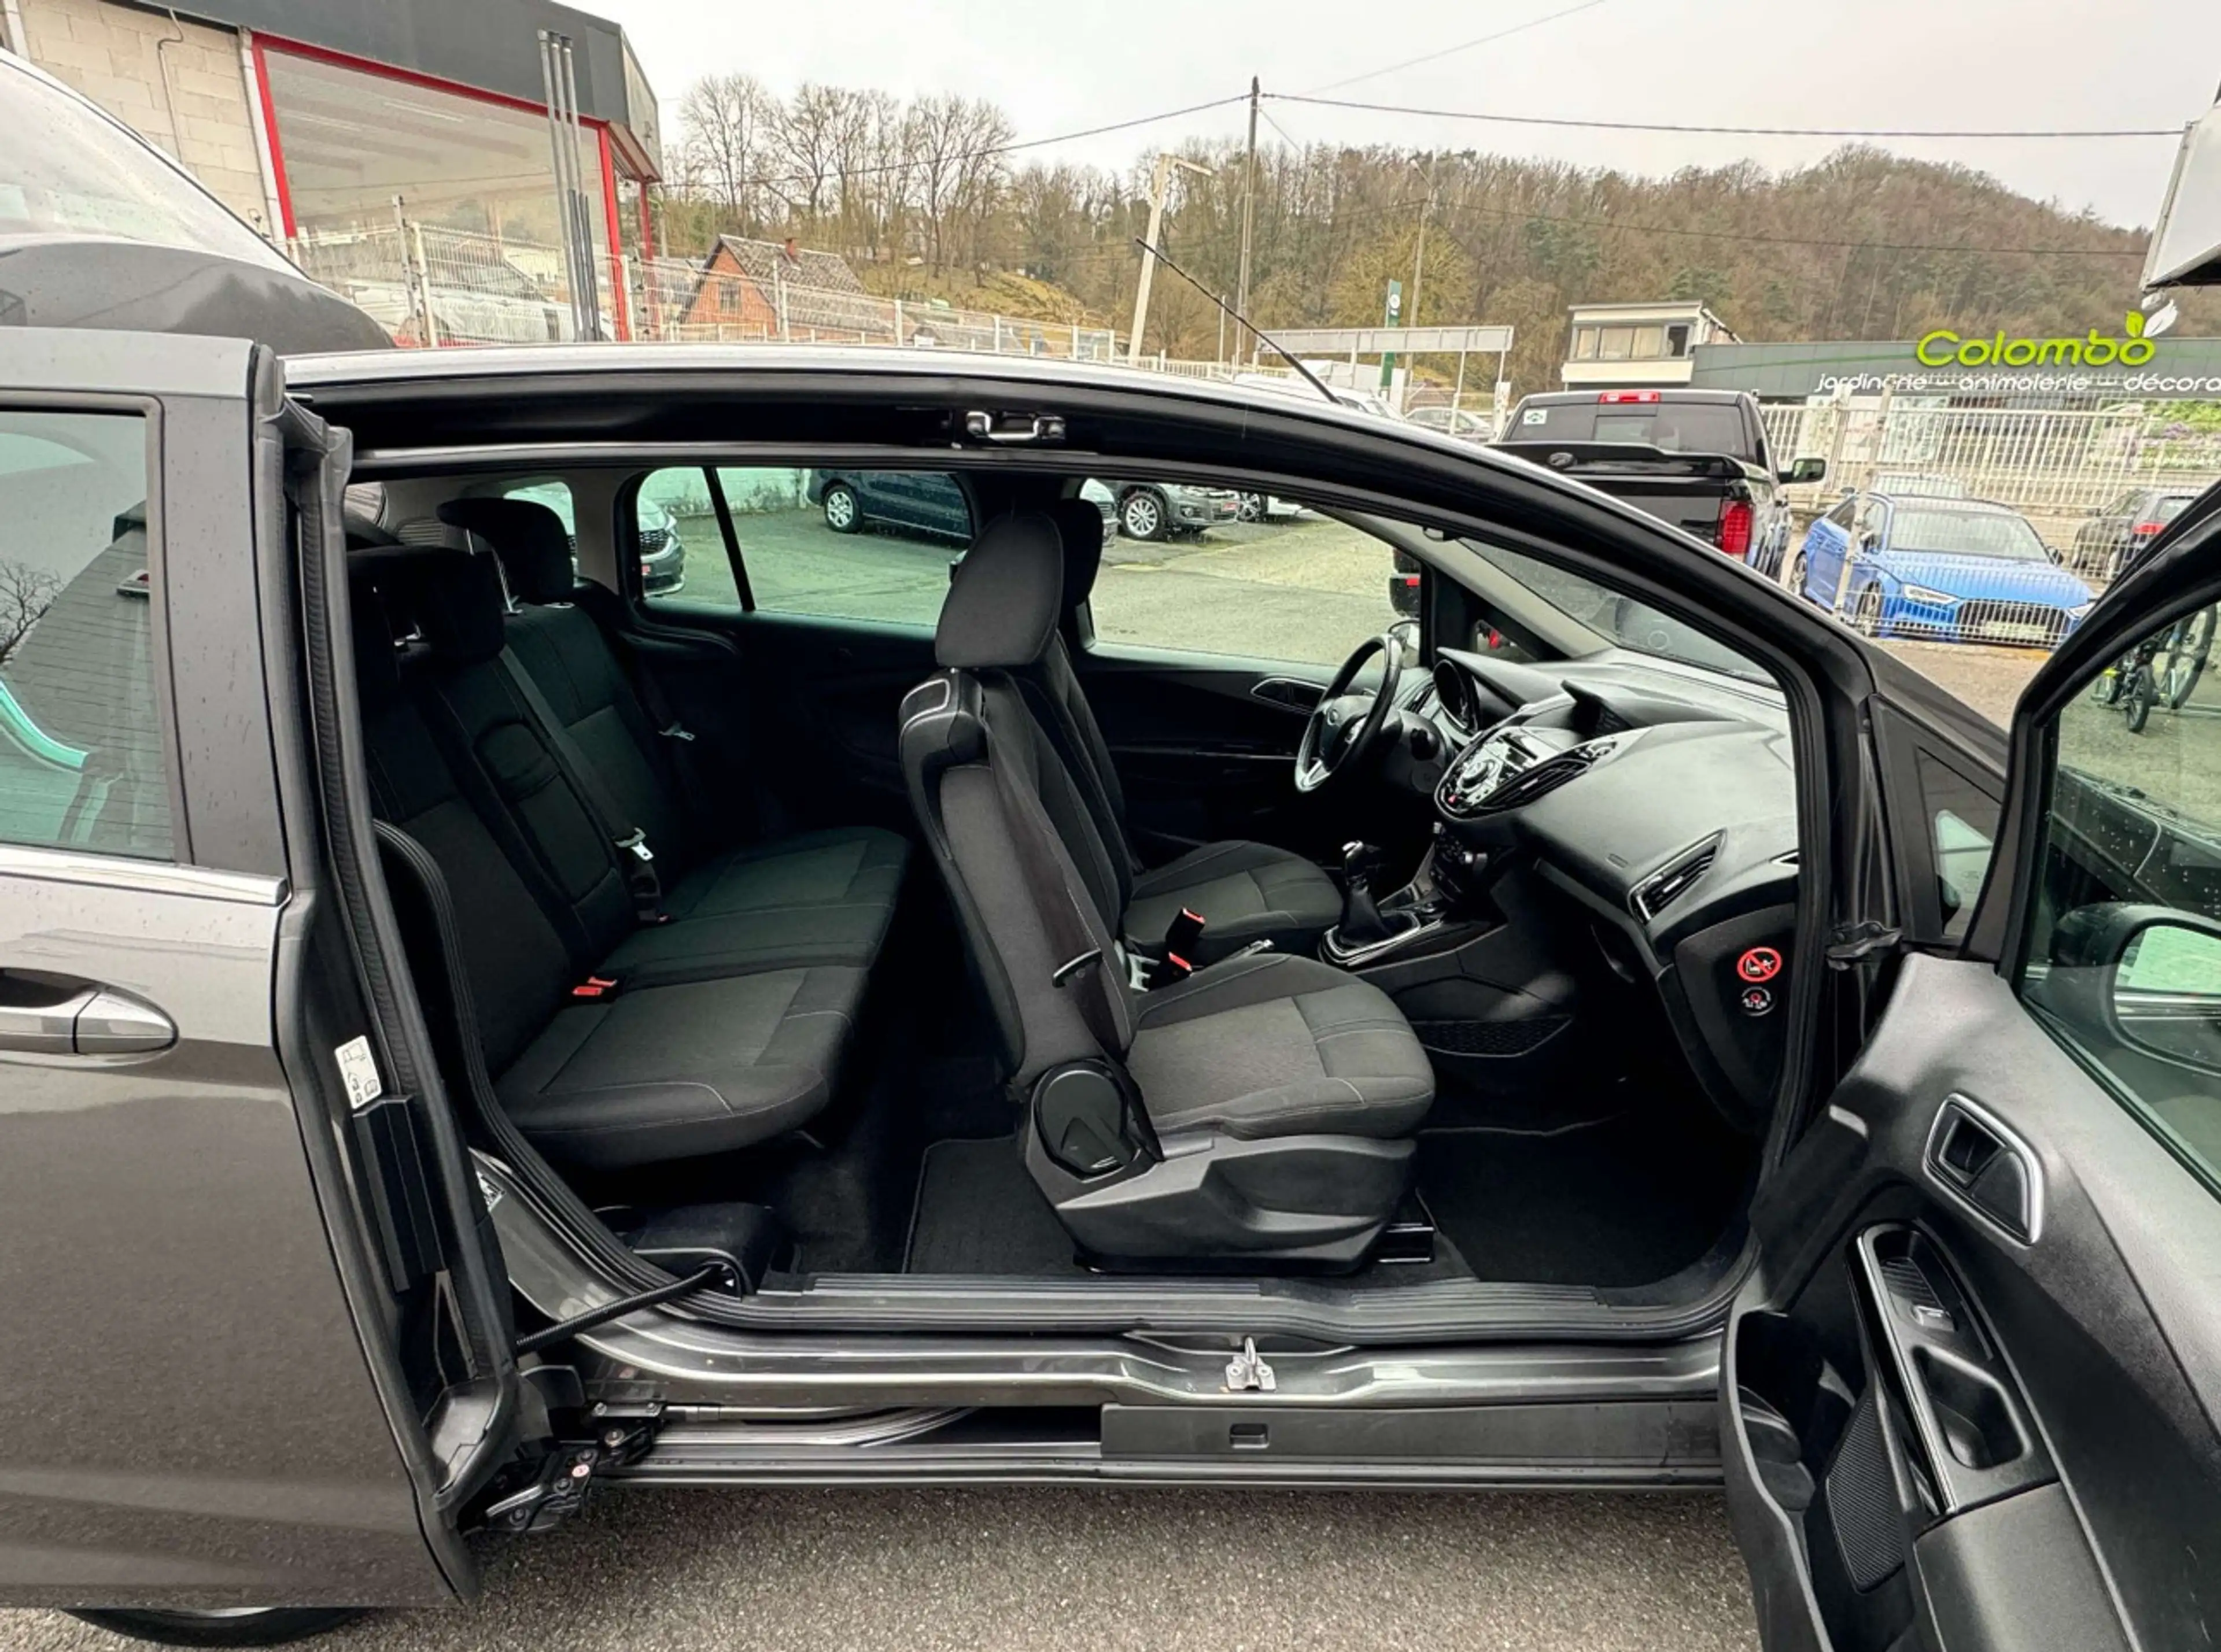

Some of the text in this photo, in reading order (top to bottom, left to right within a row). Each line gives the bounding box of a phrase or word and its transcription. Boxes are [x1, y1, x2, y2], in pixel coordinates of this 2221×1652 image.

[1917, 328, 2155, 366] Colombo
[1959, 373, 2089, 391] animalerie
[2123, 372, 2221, 391] décora
